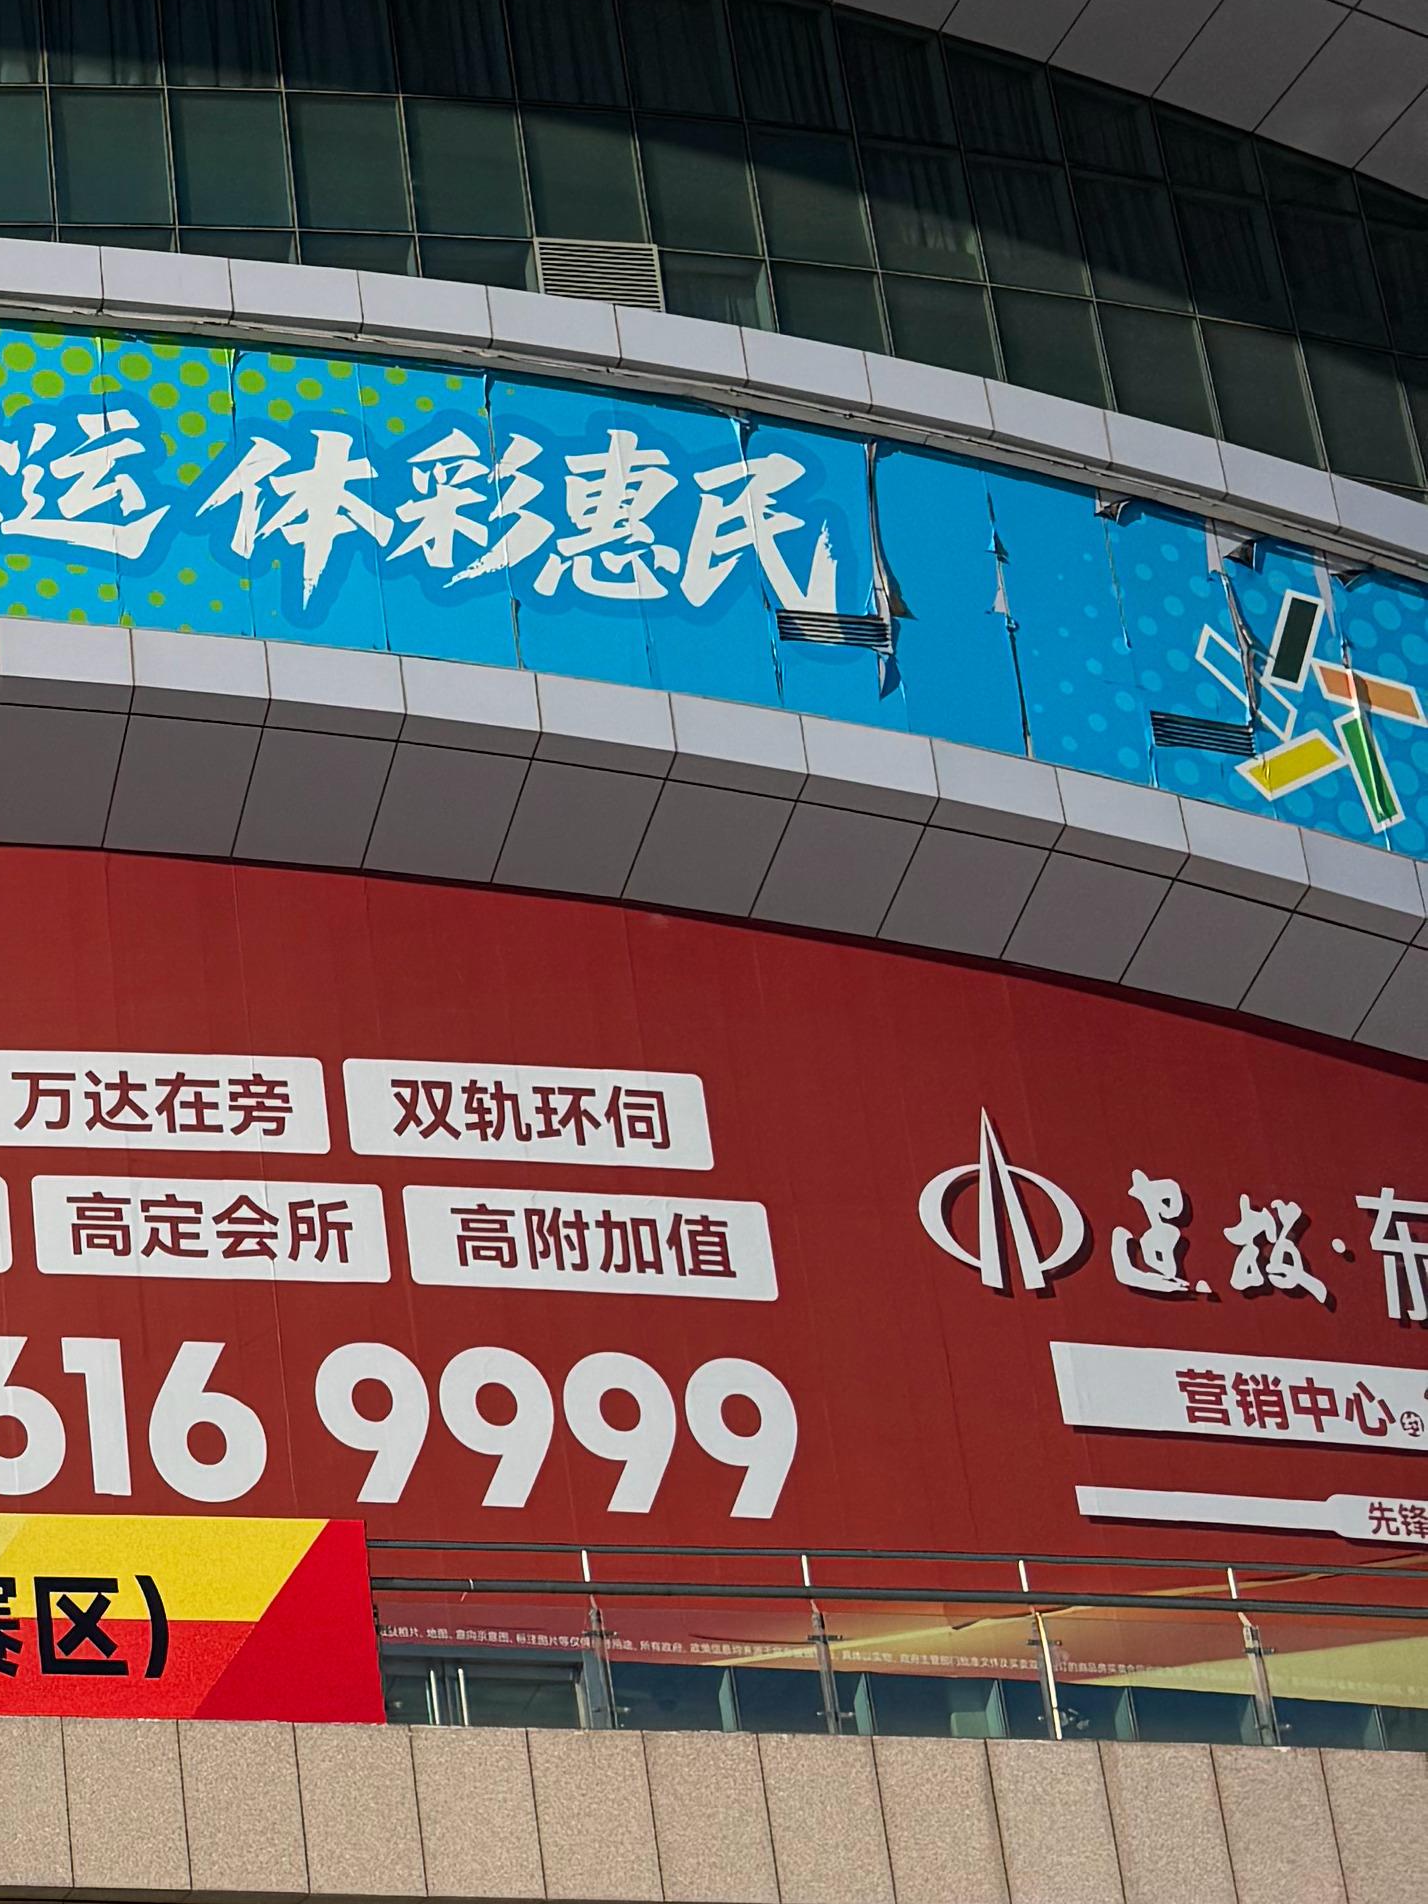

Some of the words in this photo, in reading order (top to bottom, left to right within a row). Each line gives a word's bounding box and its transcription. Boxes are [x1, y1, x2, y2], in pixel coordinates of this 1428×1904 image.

[199, 423, 842, 616] 体彩惠民
[9, 1068, 296, 1141] 万达在旁
[390, 1076, 672, 1153] 双轨环伺
[66, 1188, 358, 1268] 高定会所
[453, 1202, 741, 1281] 高附加值
[313, 1340, 801, 1522] 9999
[1175, 1368, 1397, 1437] 营销中心
